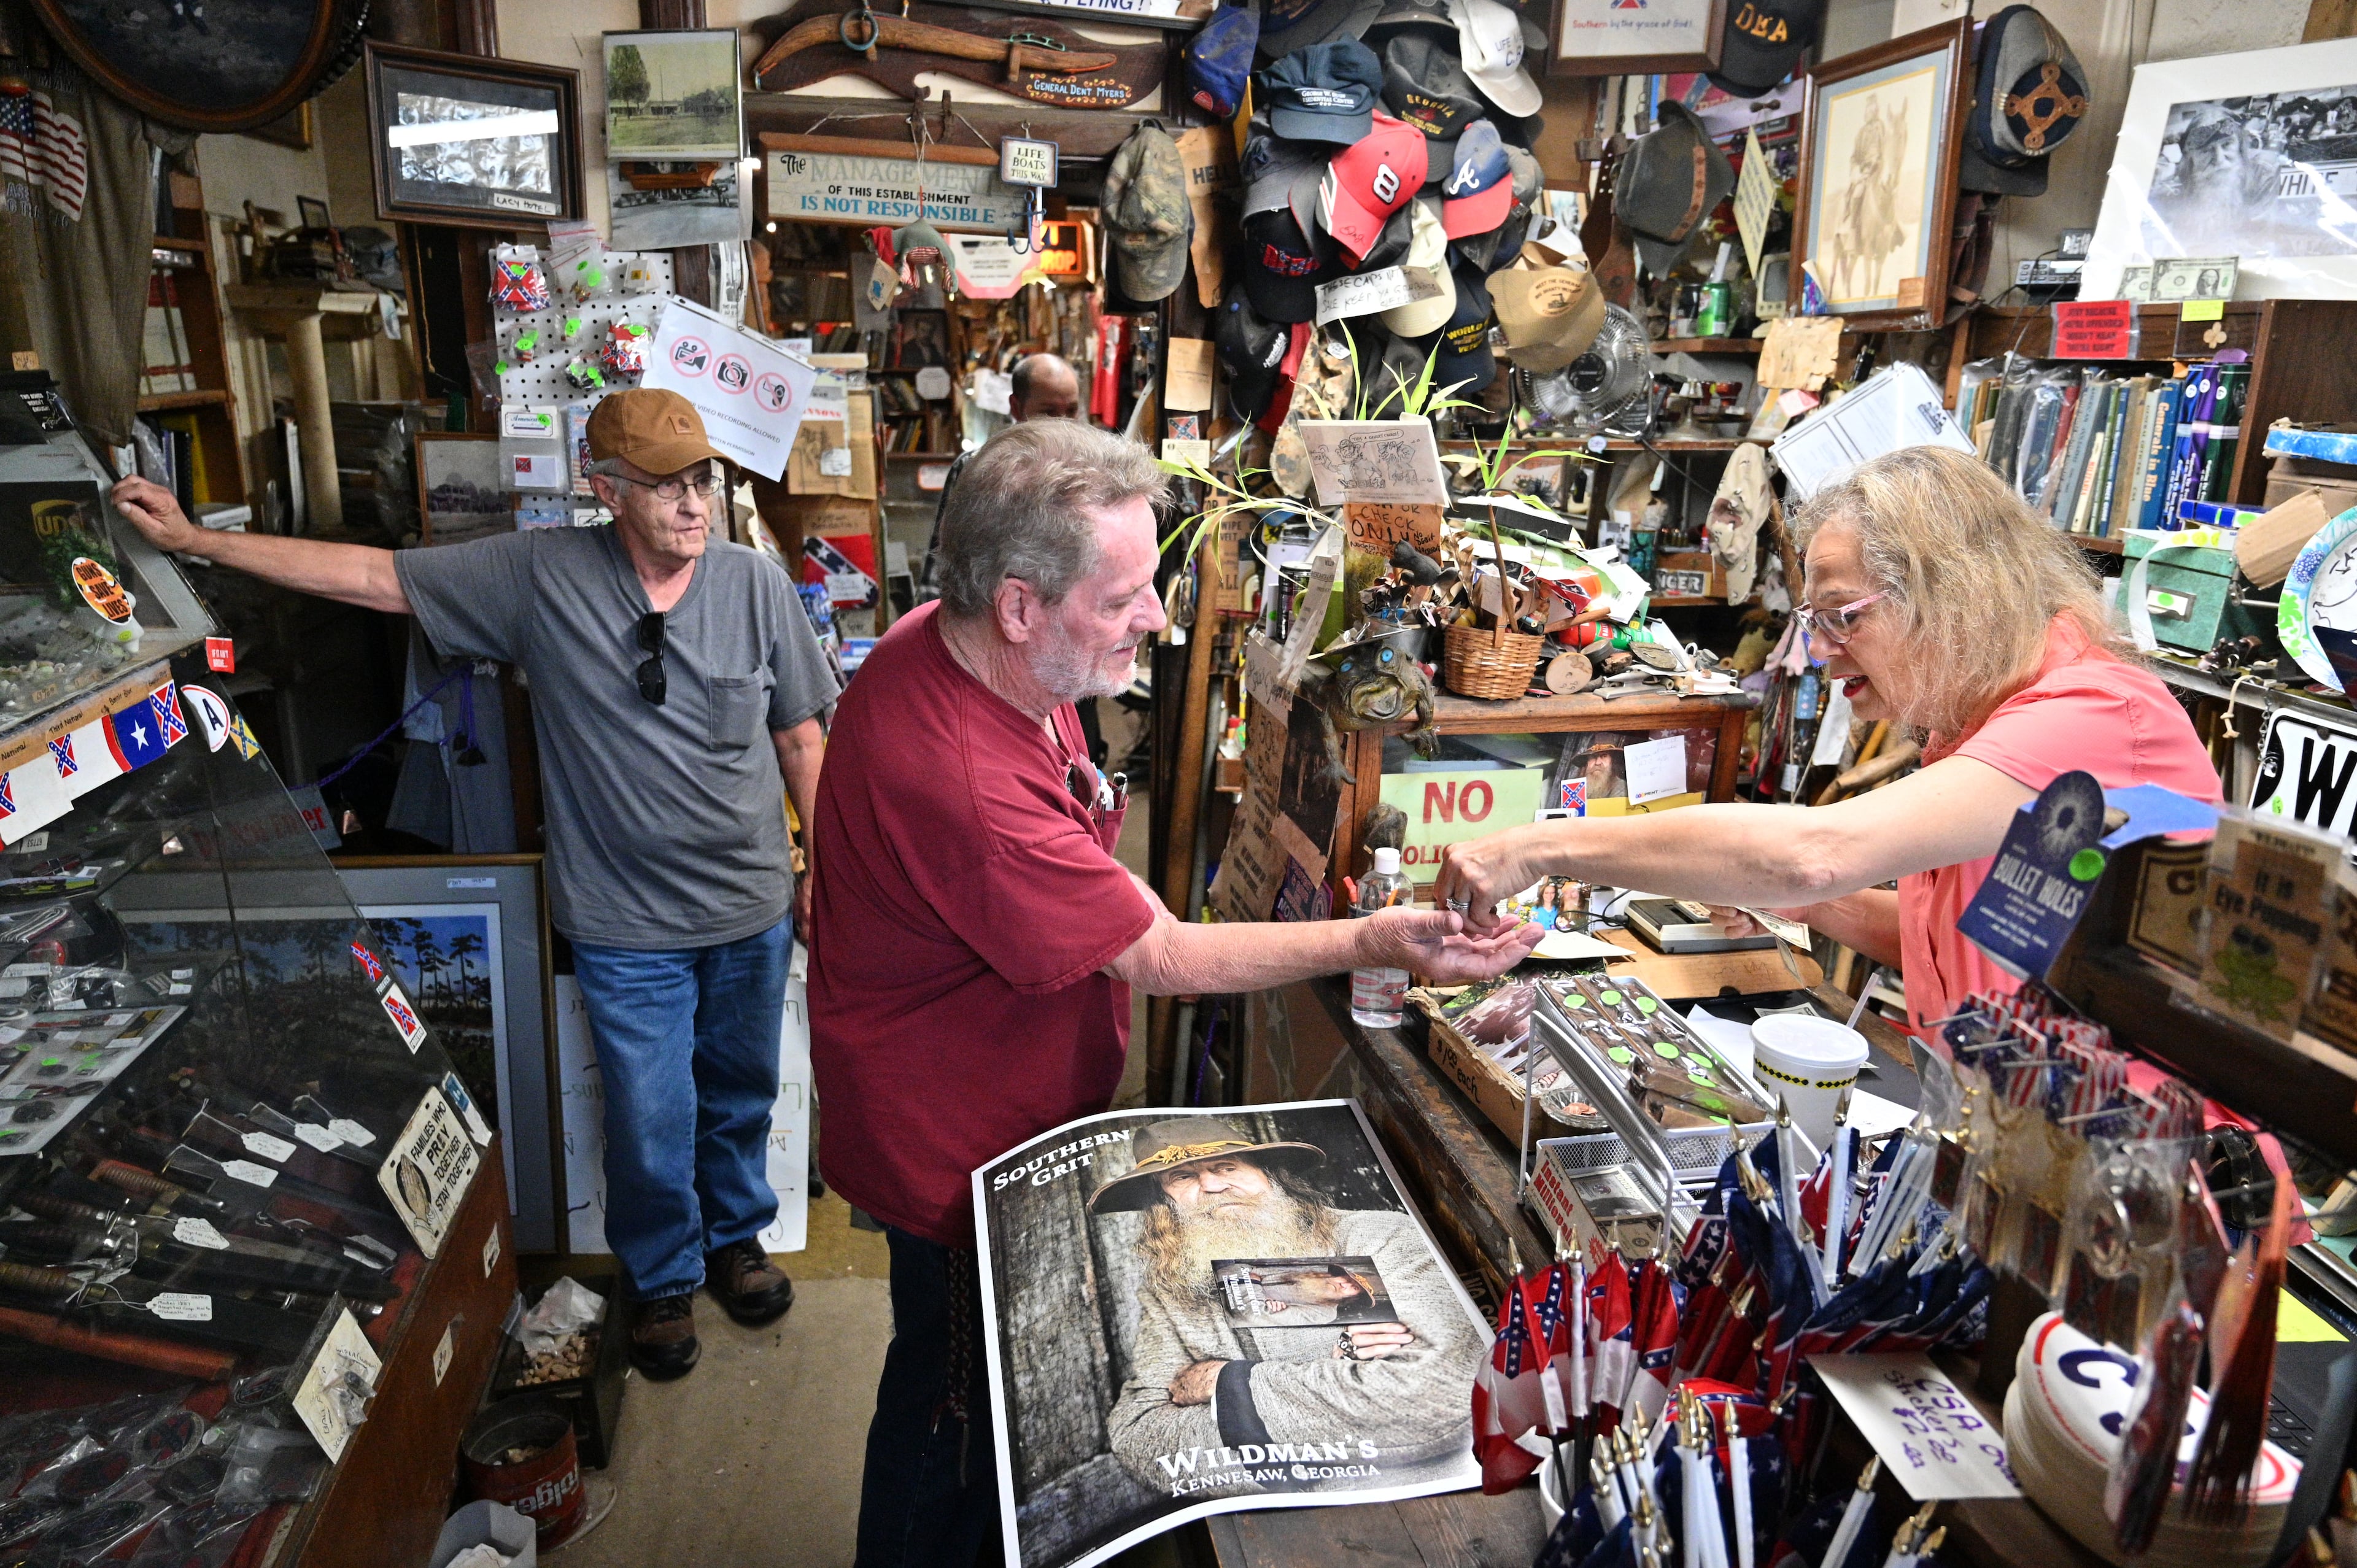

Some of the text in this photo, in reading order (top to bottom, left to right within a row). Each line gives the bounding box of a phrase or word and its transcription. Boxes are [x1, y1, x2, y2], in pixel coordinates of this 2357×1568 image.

[1572, 20, 1608, 29] Southern
[1635, 21, 1658, 31] grace
[1660, 19, 1671, 28] of
[1034, 79, 1125, 98] GENERAL DENT MYERS
[1012, 156, 1046, 171] BOATS
[1016, 147, 1045, 160] LIFE
[780, 154, 994, 196] The MANAGEMENT
[1011, 169, 1047, 182] THIS WAY
[496, 198, 552, 214] LACY HOTEL
[801, 195, 996, 224] IS NOT RESPONSIBLE
[828, 185, 970, 205] OF THIS ESTABLISHMENT
[1447, 323, 1483, 340] WORLD
[697, 403, 716, 416] VIDEO
[717, 412, 752, 431] RECORDING
[753, 427, 781, 444] ALLOWED
[803, 407, 842, 418] NNONS
[727, 442, 756, 457] PERMISSION
[2143, 401, 2170, 502] Generals in Blue
[2081, 460, 2096, 496] MILITARIA
[1361, 506, 1415, 531] CHECK
[75, 562, 103, 582] GUNS
[90, 582, 115, 600] SAVE
[102, 599, 129, 619] LIVES
[48, 710, 83, 734] Third National
[202, 698, 225, 732] A
[1, 743, 26, 760] National
[1422, 779, 1494, 824] NO
[1992, 852, 2084, 919] BULLET HOLES
[1457, 1068, 1480, 1104] each
[410, 1100, 447, 1161] FAMILIES WHO
[433, 1137, 462, 1183] TOGETHER
[992, 1129, 1131, 1192] SOUTHERN
[1031, 1152, 1095, 1188] GRIT
[434, 1143, 473, 1214] STAY TOGETHER
[1541, 1159, 1575, 1218] Instant
[1230, 1273, 1245, 1311] WILDMAN'S
[1240, 1267, 1261, 1316] SOUTHERN GRIT
[1156, 1434, 1380, 1480] WILDMAN'S
[1169, 1464, 1382, 1498] KENNESAW, GEORGIA
